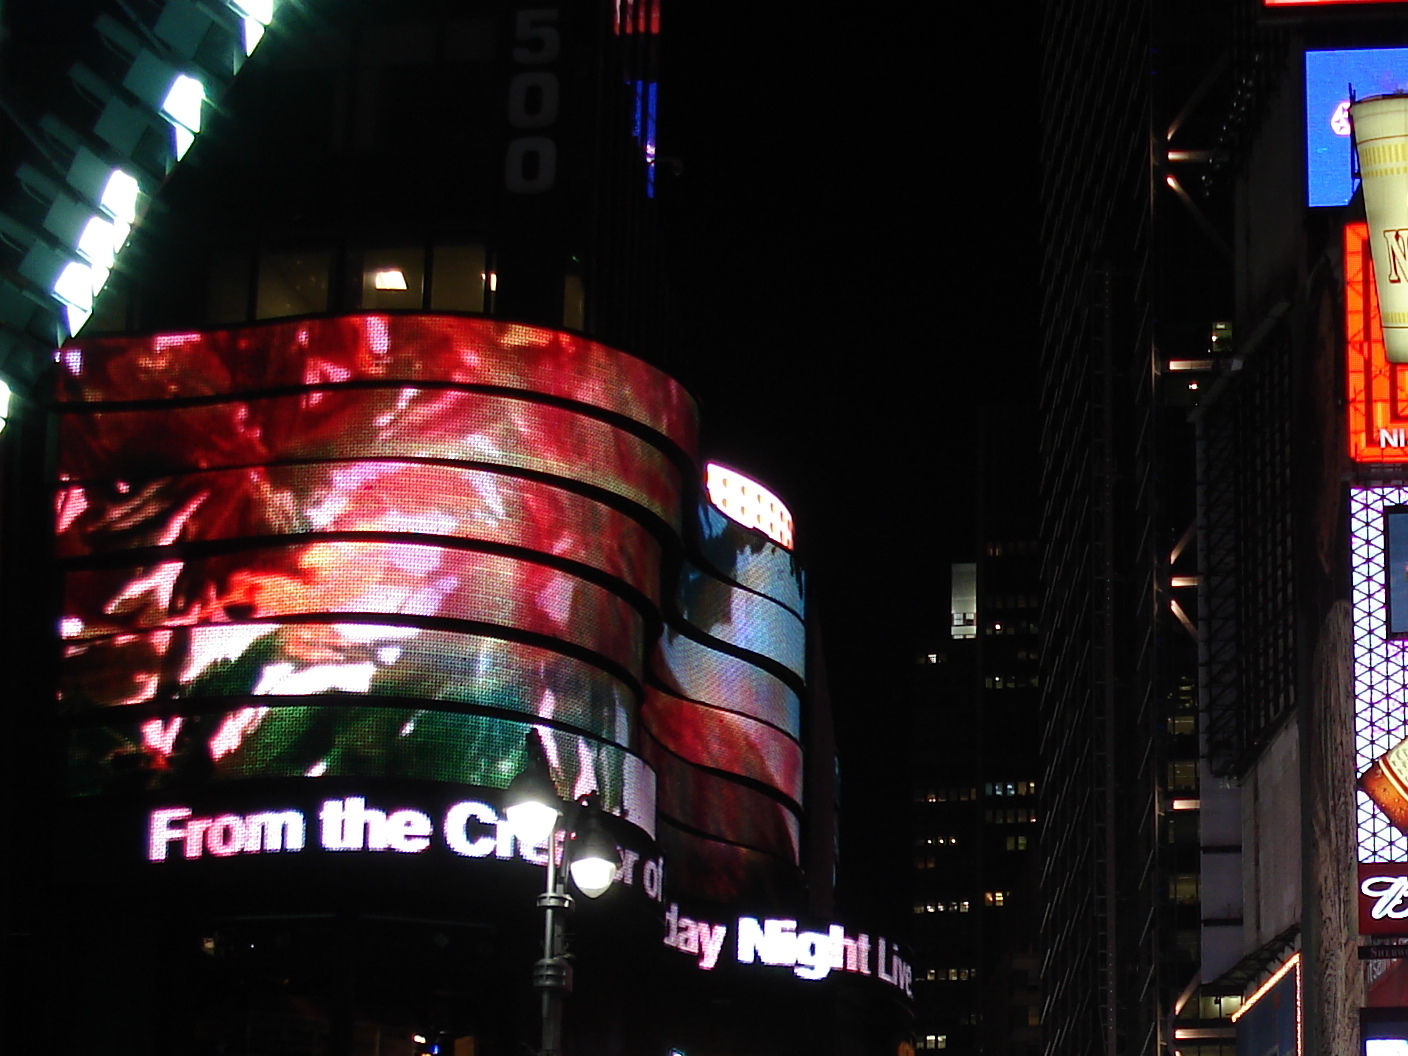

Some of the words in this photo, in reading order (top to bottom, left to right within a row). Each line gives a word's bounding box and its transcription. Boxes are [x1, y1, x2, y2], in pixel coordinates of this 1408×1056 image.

[149, 807, 305, 862] From
[320, 797, 433, 852] the
[738, 916, 872, 980] Night
